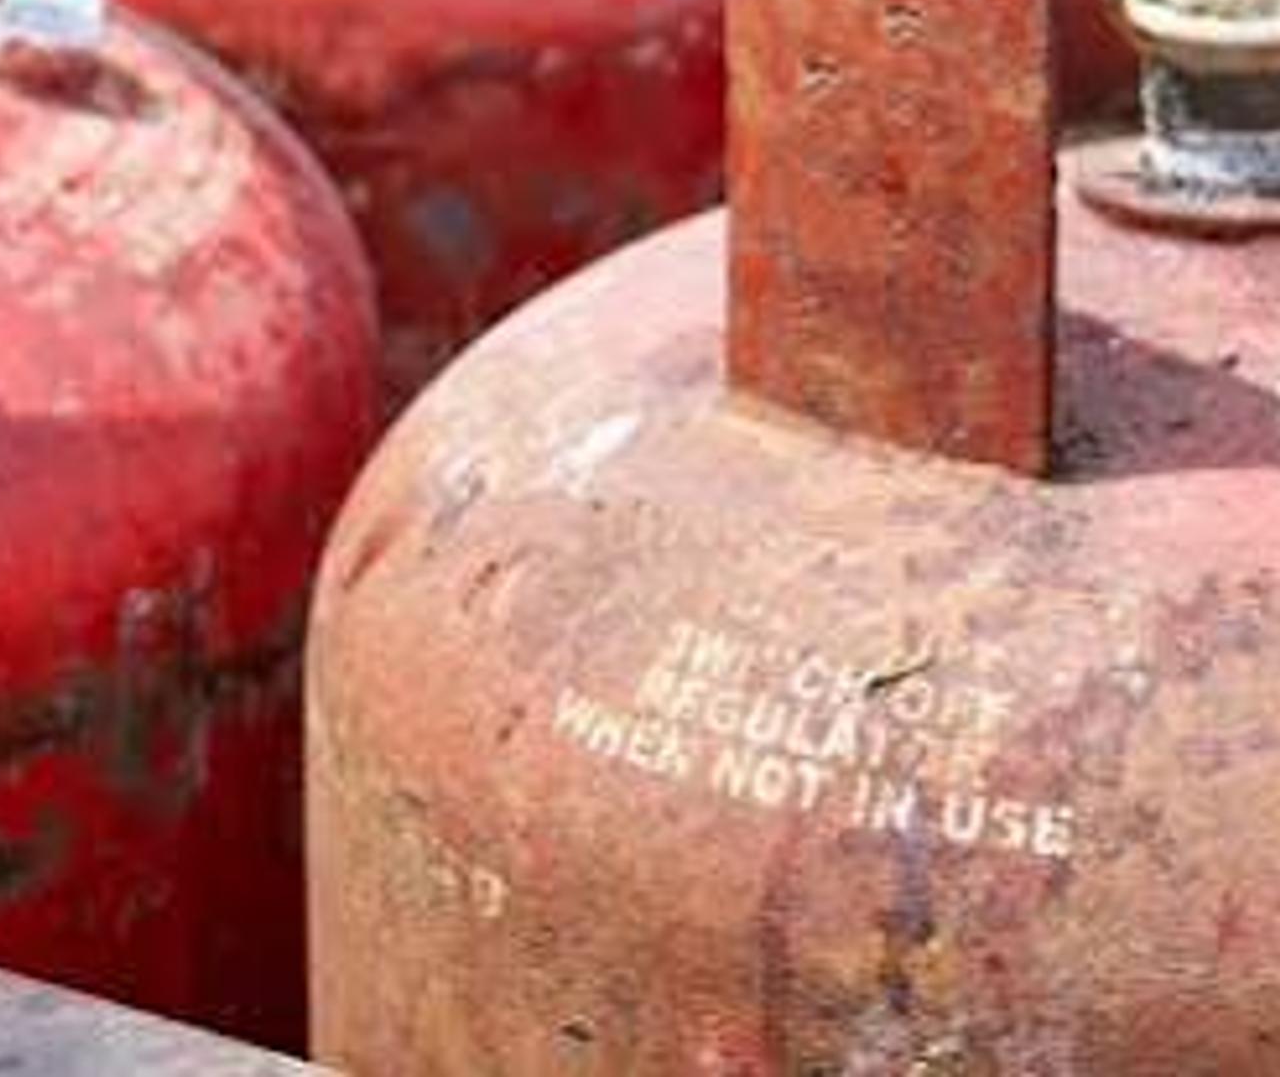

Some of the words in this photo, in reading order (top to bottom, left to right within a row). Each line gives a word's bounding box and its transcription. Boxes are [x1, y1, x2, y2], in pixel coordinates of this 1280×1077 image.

[552, 687, 692, 780] WHEN
[711, 754, 827, 810] NOT
[851, 775, 918, 833] IN
[942, 789, 1076, 857] USE
